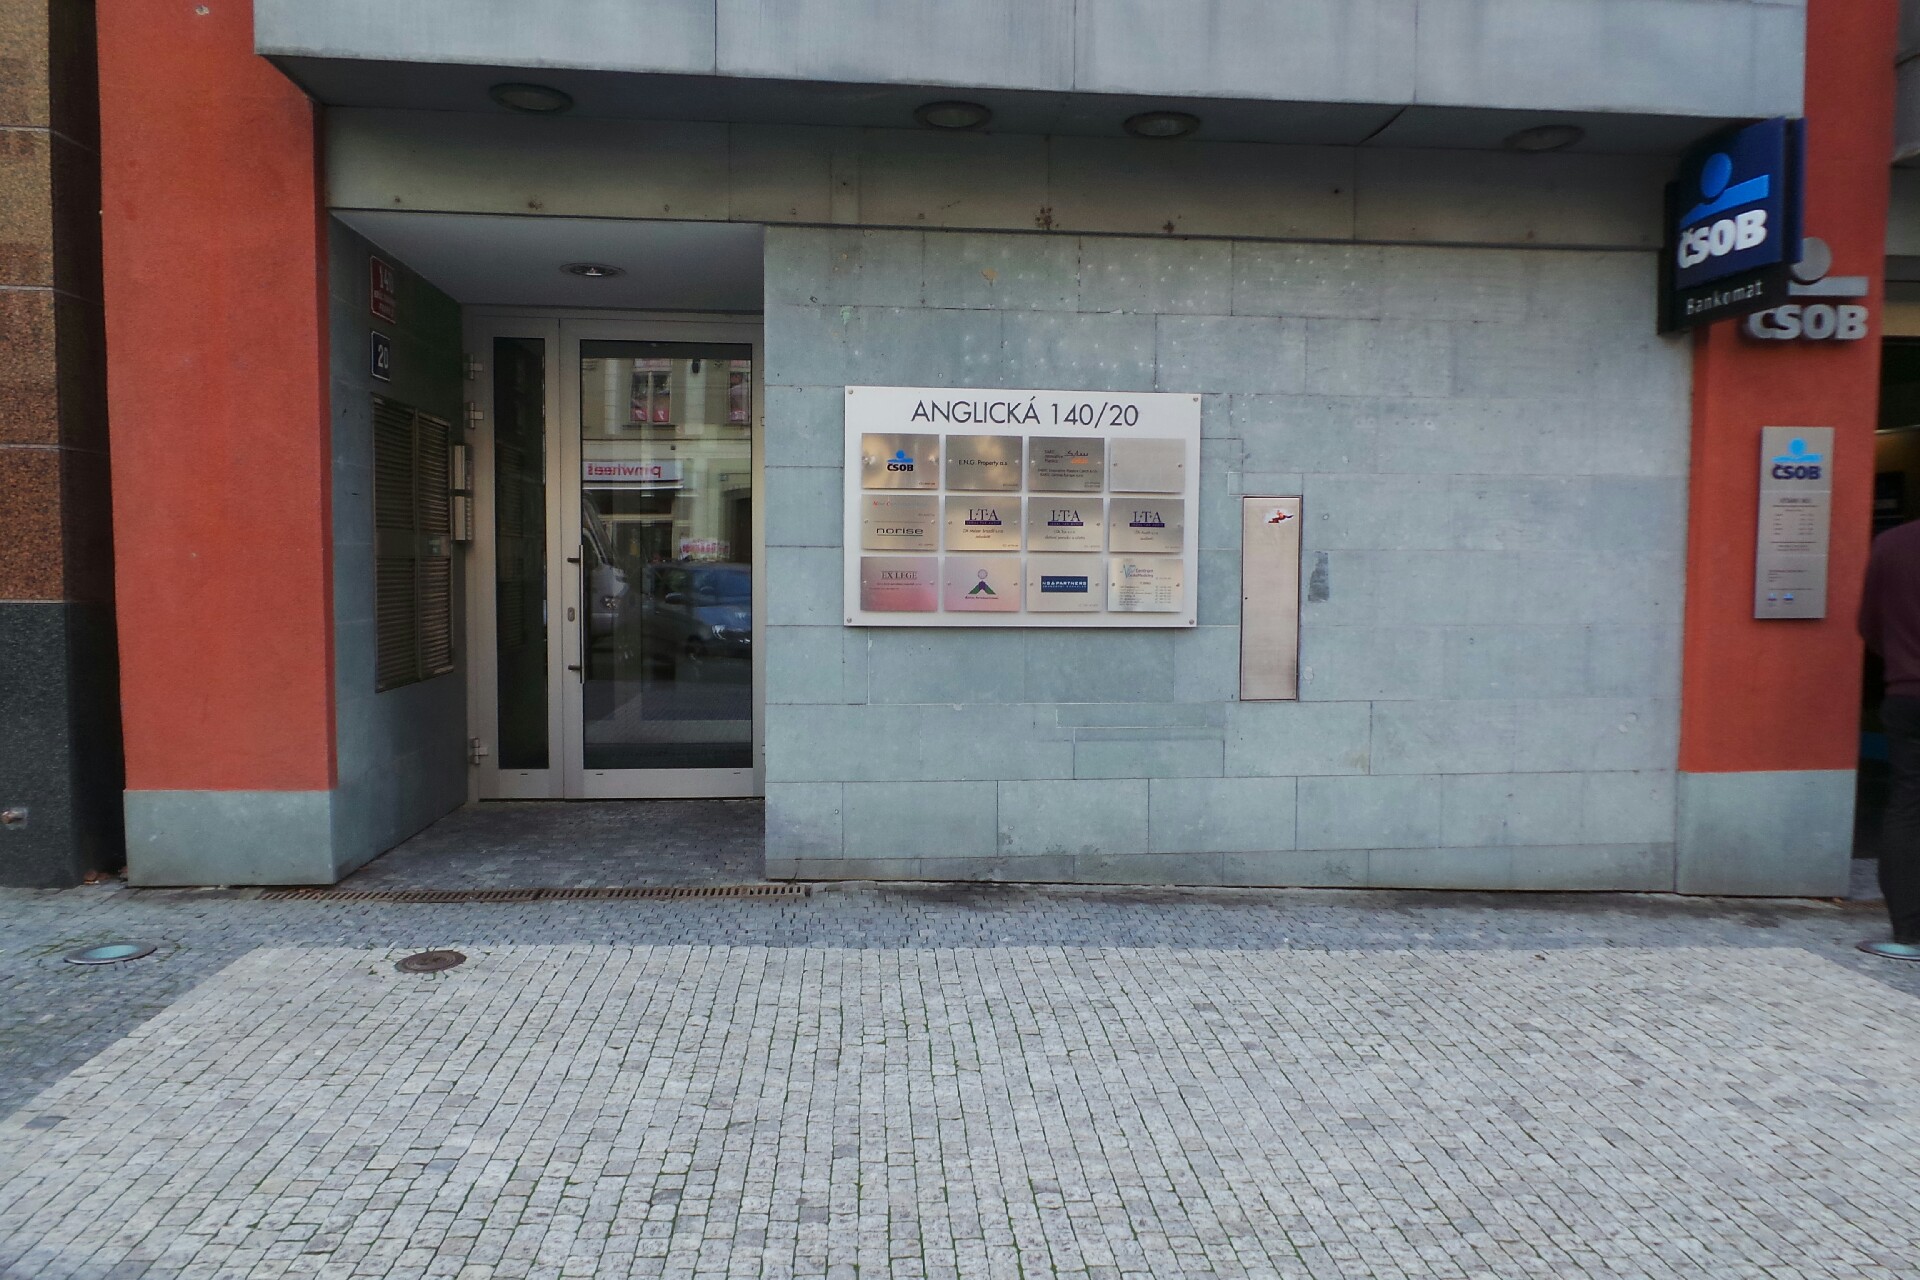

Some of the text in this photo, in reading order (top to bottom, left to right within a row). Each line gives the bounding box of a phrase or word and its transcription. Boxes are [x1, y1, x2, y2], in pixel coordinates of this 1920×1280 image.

[1686, 279, 1764, 315] Bankomat
[377, 344, 389, 369] 20
[911, 396, 1139, 429] ANGLICKÁ 140/20
[977, 459, 999, 467] Property
[1772, 464, 1822, 480] ČSOB
[876, 527, 924, 535] norise
